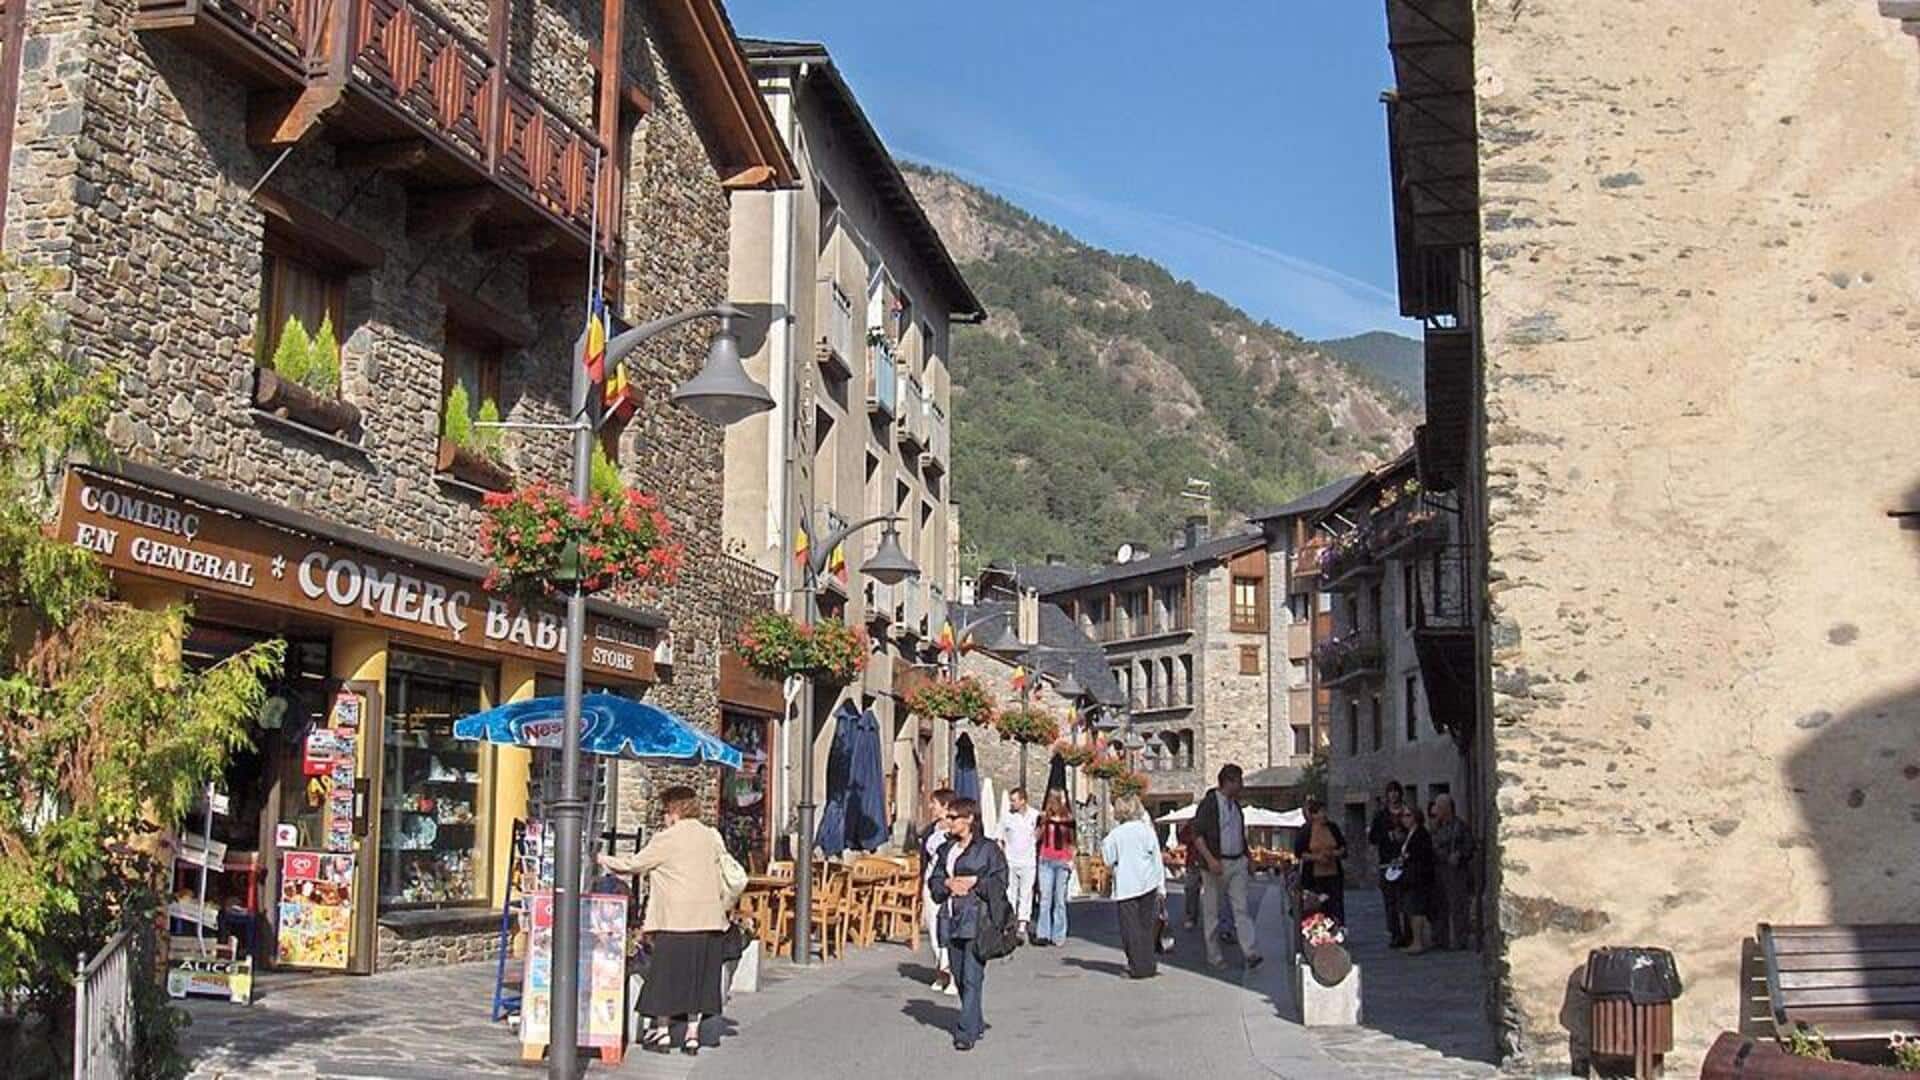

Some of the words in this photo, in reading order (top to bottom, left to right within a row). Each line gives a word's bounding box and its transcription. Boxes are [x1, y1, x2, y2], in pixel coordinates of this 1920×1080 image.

[80, 485, 200, 542] COMERÇ
[74, 522, 119, 555] EN
[130, 536, 255, 587] GENERAL
[297, 551, 471, 641] COMERÇ
[591, 646, 635, 671] STORE
